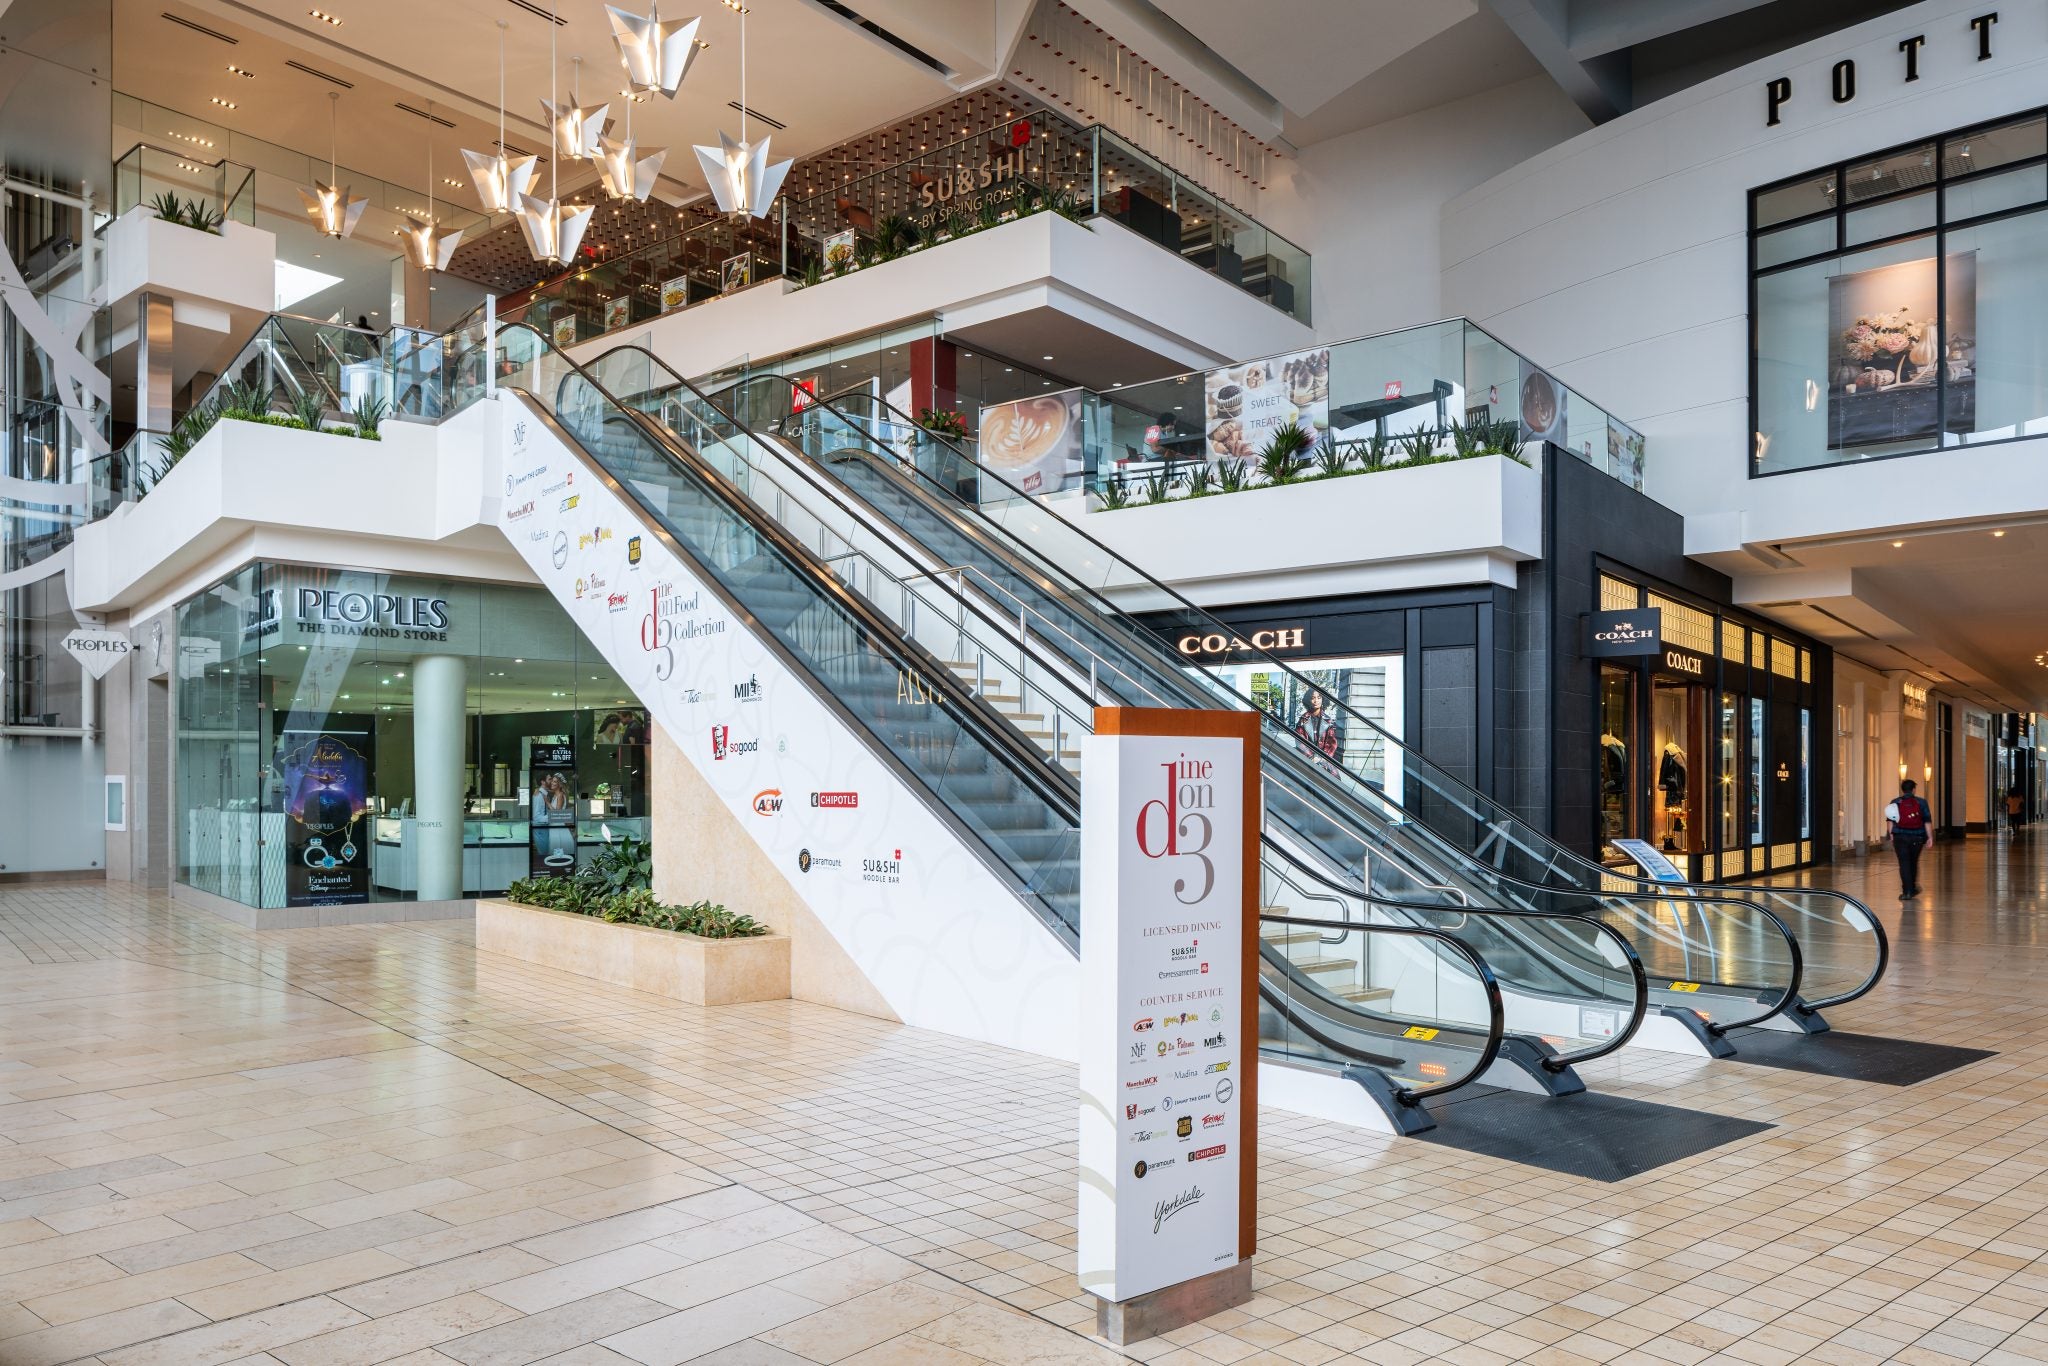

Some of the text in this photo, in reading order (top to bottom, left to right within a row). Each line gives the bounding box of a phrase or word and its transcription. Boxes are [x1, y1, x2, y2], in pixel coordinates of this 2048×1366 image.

[1766, 12, 1998, 127] POTT
[922, 149, 1025, 208] SU&SHI
[922, 210, 937, 229] BY
[1386, 384, 1401, 398] illy
[1251, 395, 1281, 409] SWEET
[1250, 416, 1283, 429] TREATS
[1147, 429, 1160, 440] illy
[1025, 477, 1041, 489] illy
[298, 588, 449, 629] PEOPLES
[658, 602, 673, 617] on
[674, 592, 699, 614] Food
[297, 622, 448, 642] THE DIAMOND STORE
[674, 617, 725, 641] Collection
[1594, 629, 1654, 641] COACH
[67, 638, 128, 653] PEOPLES
[1179, 628, 1305, 654] COACH
[656, 619, 674, 682] 3
[1666, 651, 1702, 675] COACH
[820, 795, 857, 805] CHIPOTLE
[1178, 783, 1215, 809] on
[757, 798, 783, 812] A&W
[812, 857, 842, 868] paramount
[1174, 812, 1215, 905] 3
[863, 859, 900, 874] SU&SHI
[308, 874, 351, 884] Enchanted
[863, 874, 900, 884] NOODLE BAR
[1143, 921, 1222, 937] LICENSED DINING
[1171, 946, 1197, 956] SU&SHI
[1140, 987, 1224, 1007] COUNTER SERVICE
[1136, 1021, 1154, 1032] A&W
[1174, 1069, 1198, 1080] Madina
[1196, 1145, 1225, 1159] CHIPOTLE
[1147, 1158, 1176, 1170] paramount
[1153, 1185, 1205, 1234] Yorkdale
